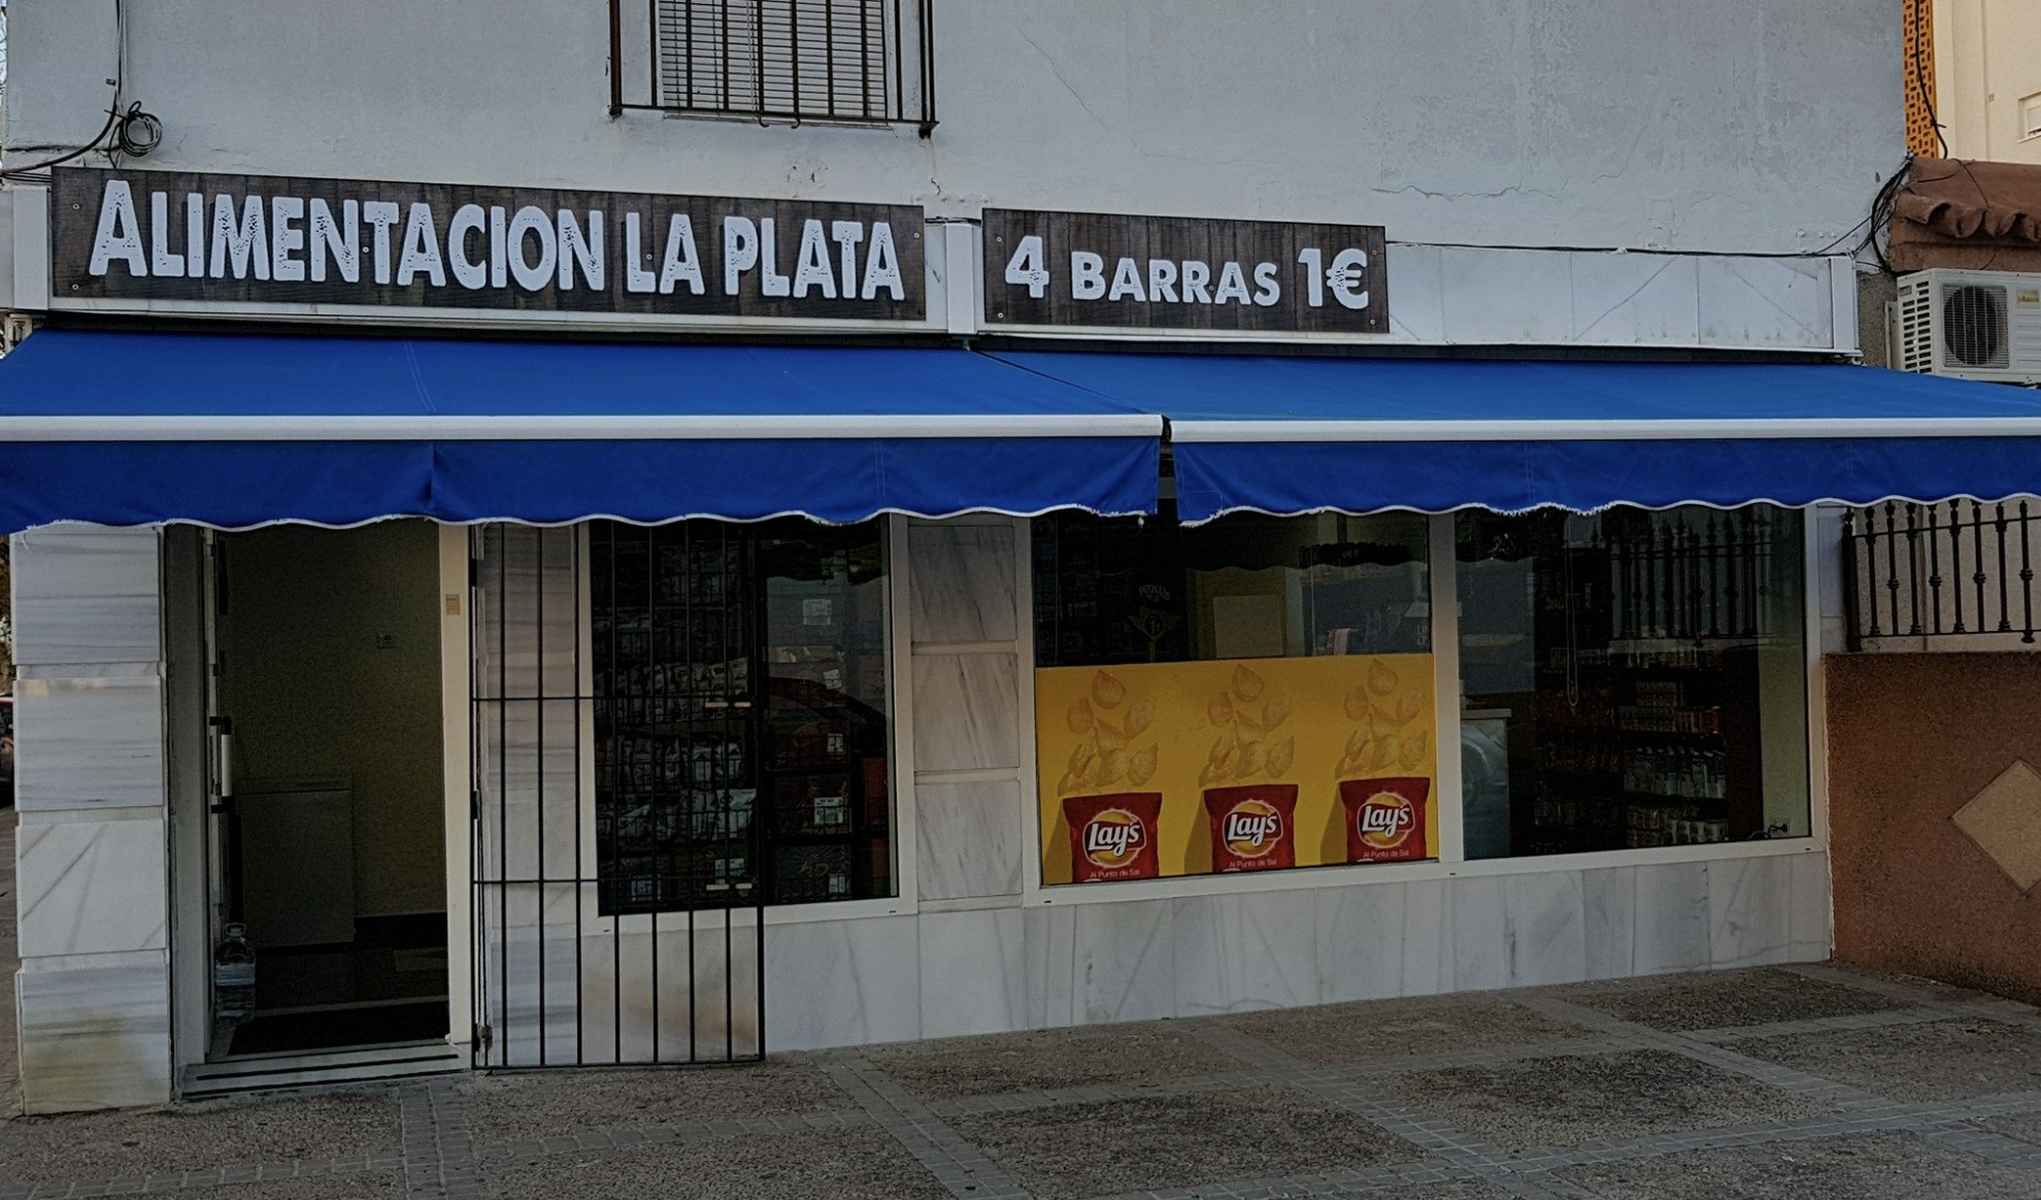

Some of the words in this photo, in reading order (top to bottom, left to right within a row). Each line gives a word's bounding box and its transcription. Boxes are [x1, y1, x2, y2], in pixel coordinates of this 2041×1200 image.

[88, 179, 606, 293] ALIMENTACION
[625, 211, 705, 296] LA
[722, 214, 906, 302] PLATA
[1005, 234, 1050, 298] 4
[1071, 250, 1281, 307] BARRAS
[1297, 247, 1370, 310] 1€
[1228, 812, 1278, 847] Lay's
[1362, 805, 1410, 838] Lay's
[1088, 822, 1141, 857] Lay's
